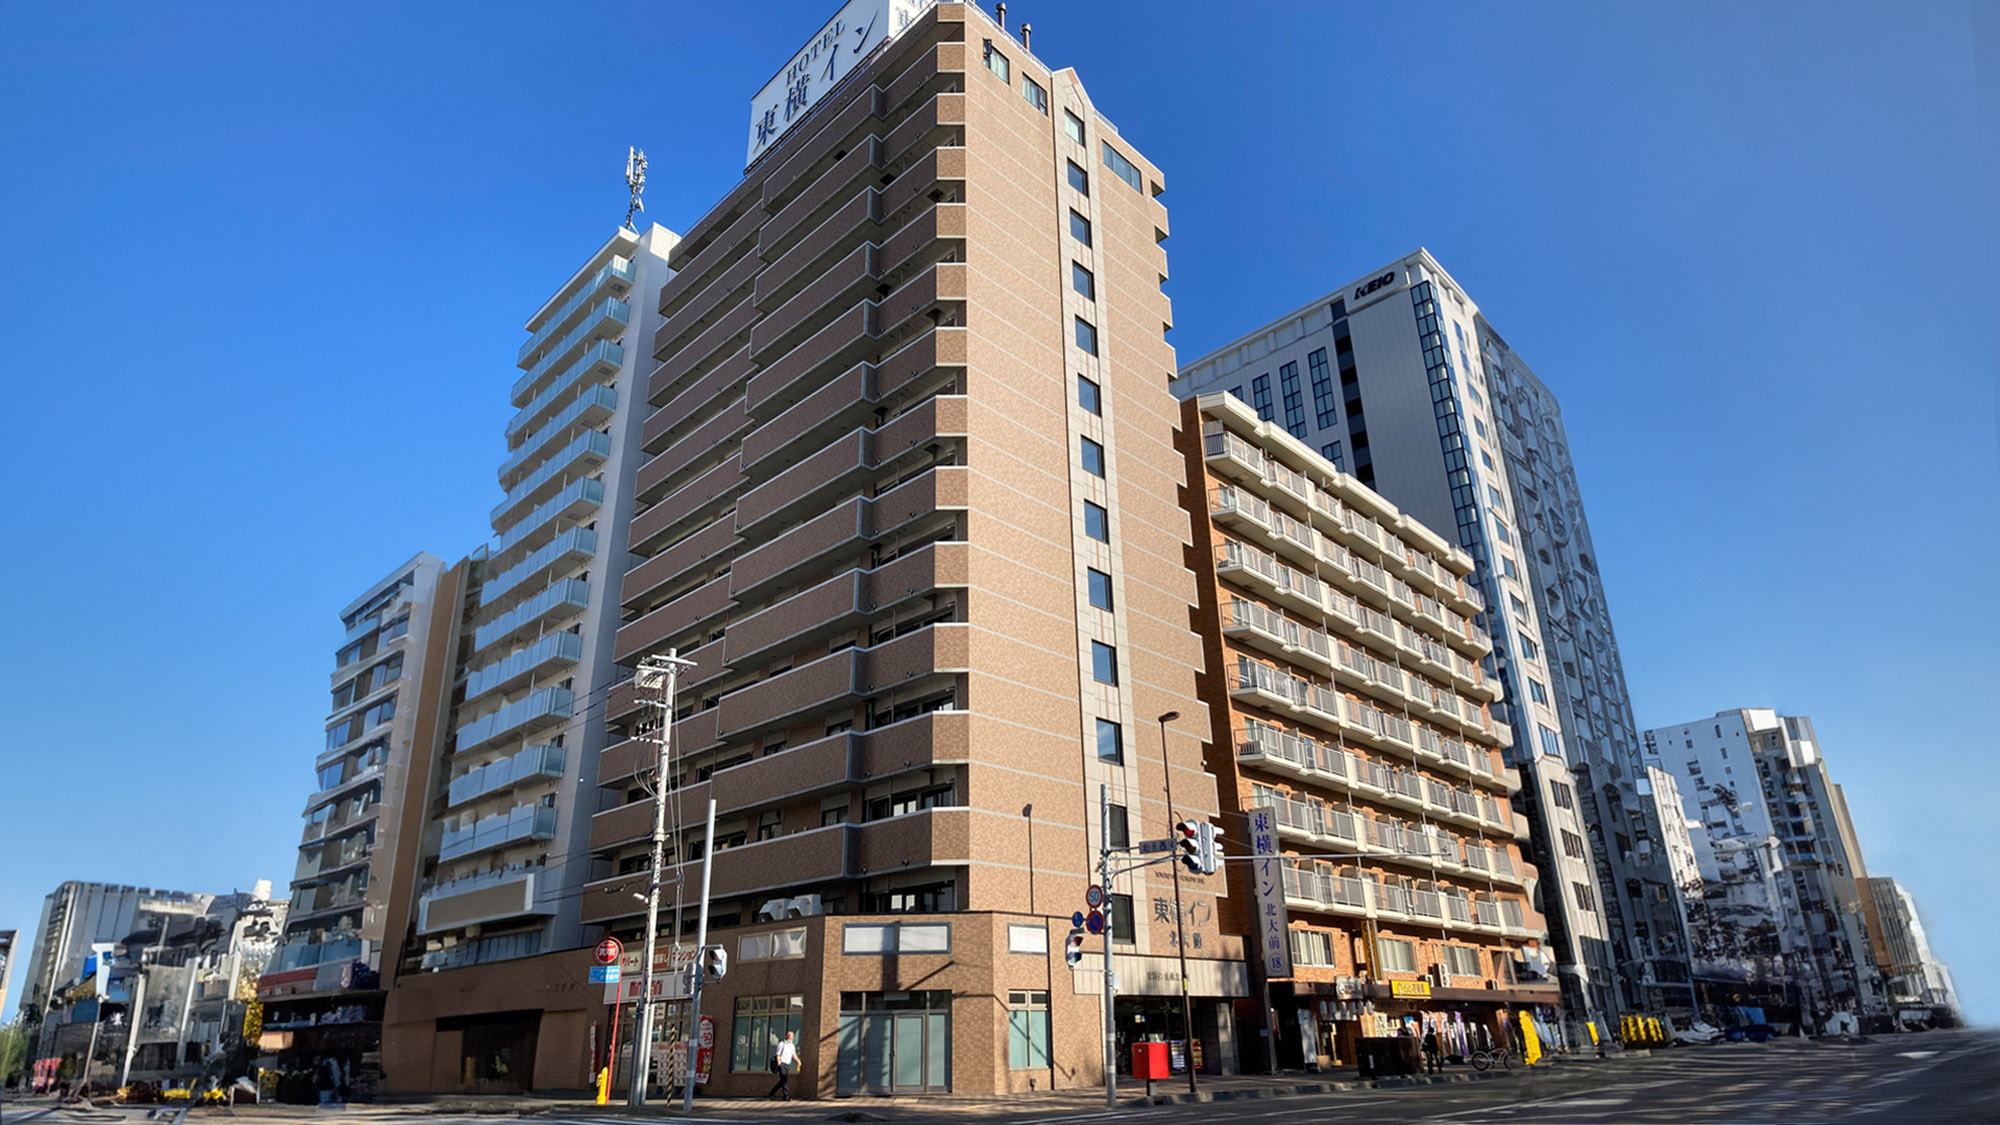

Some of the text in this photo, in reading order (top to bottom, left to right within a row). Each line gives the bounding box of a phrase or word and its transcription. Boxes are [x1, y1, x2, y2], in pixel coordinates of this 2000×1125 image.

[752, 9, 880, 155] 東横イン
[784, 18, 847, 87] HOTEL
[1353, 271, 1396, 301] KEIO
[1088, 890, 1101, 903] 50
[1254, 812, 1282, 969] 東横イン 北大前 18
